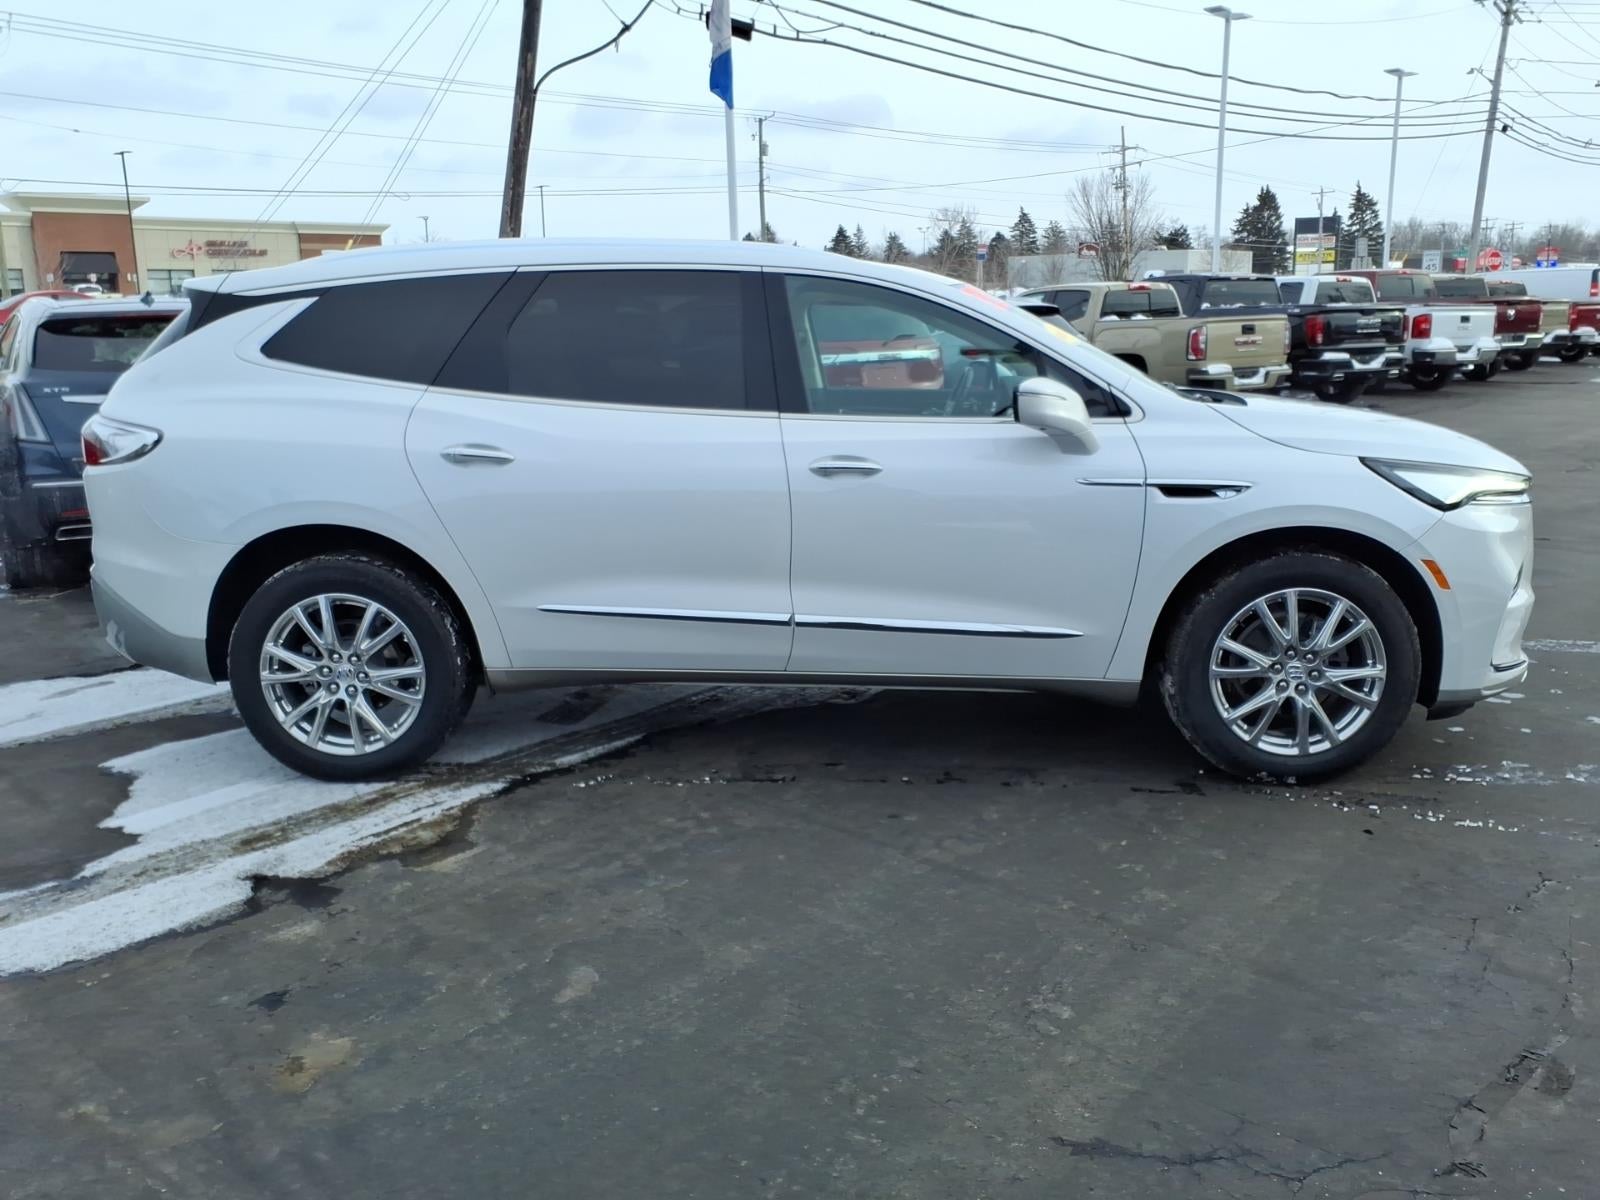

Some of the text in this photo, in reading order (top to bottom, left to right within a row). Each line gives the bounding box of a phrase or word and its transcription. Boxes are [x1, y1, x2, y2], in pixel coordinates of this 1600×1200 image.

[1488, 257, 1503, 265] STOP
[1424, 263, 1438, 271] 45
[1235, 336, 1263, 346] GMC
